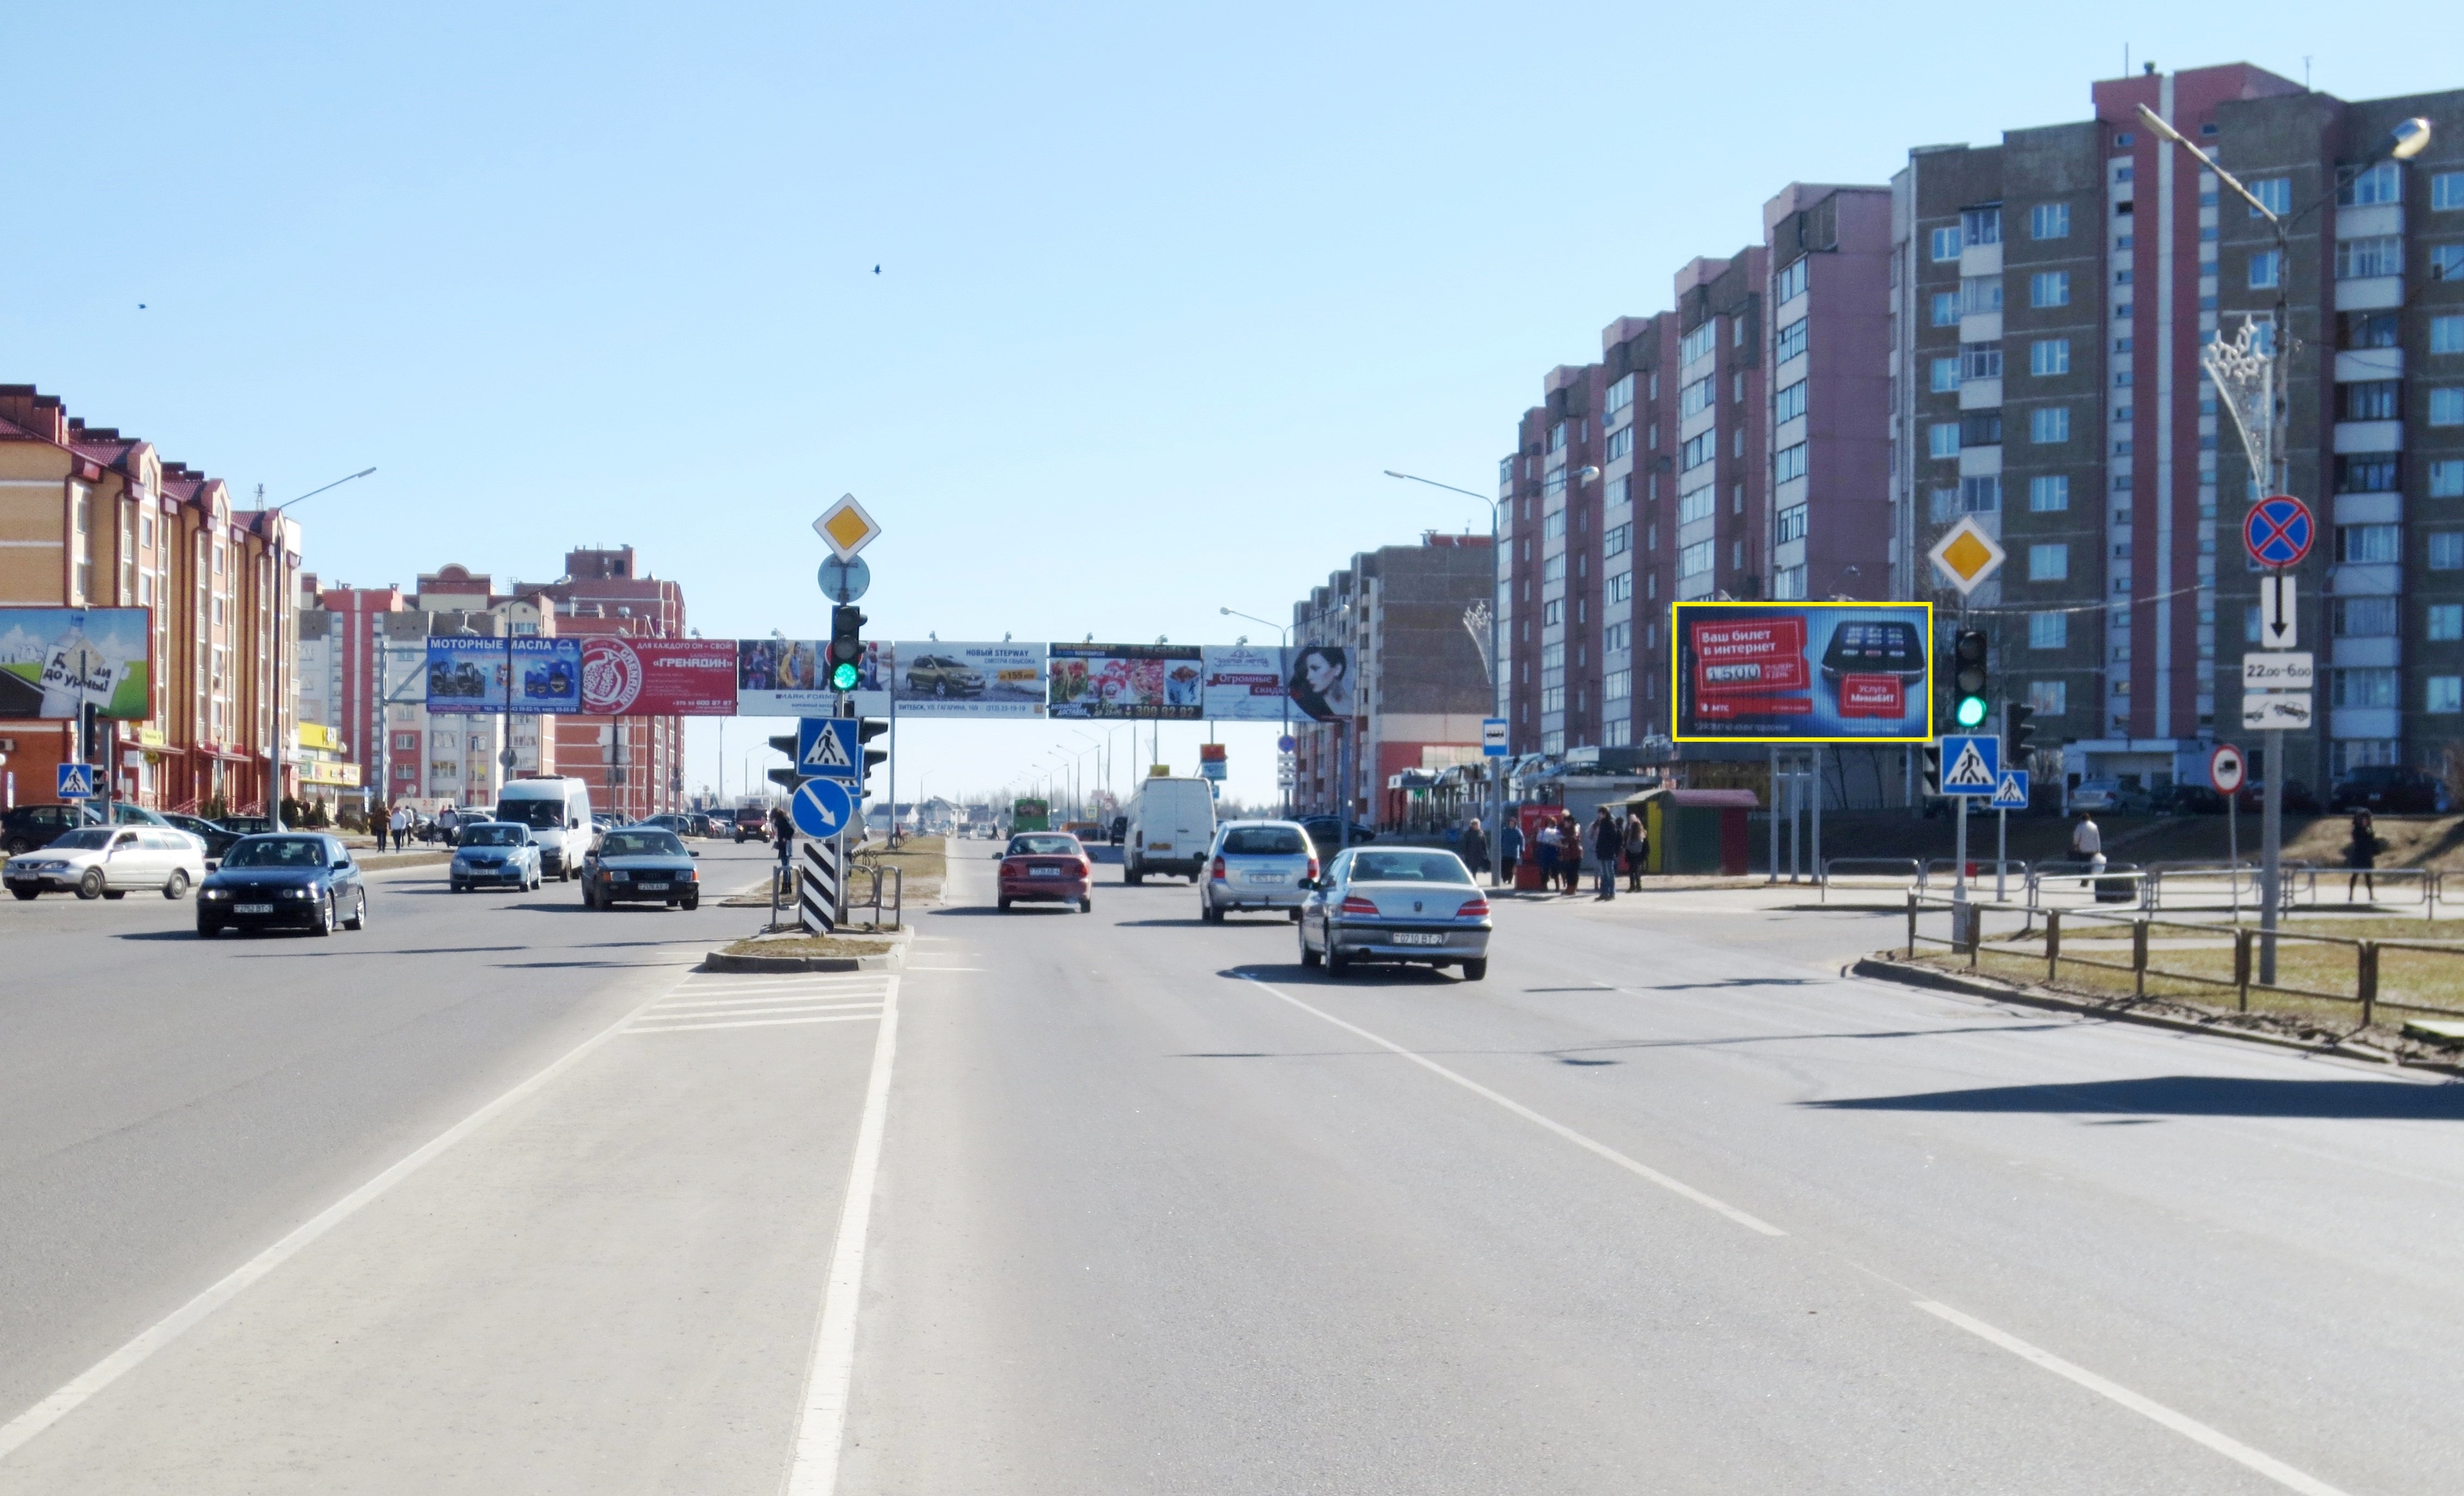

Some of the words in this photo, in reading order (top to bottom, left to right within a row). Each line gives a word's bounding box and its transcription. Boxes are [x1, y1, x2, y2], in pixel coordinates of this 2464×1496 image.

[1701, 631, 1729, 643] Ваш
[1732, 629, 1771, 641] билет
[430, 638, 504, 649] МОТОРНЫЕ
[1703, 647, 1712, 656] в
[1714, 642, 1776, 655] интернет
[966, 648, 993, 656] НОВЫЙ
[653, 657, 733, 668] «ГРЕНАДИН»
[43, 668, 63, 681] до
[1709, 664, 1759, 681] 1500
[1219, 674, 1273, 685] Огромные
[1255, 687, 1290, 696] скидк
[1858, 685, 1887, 694] Услуга
[1400, 933, 1419, 944] 0710
